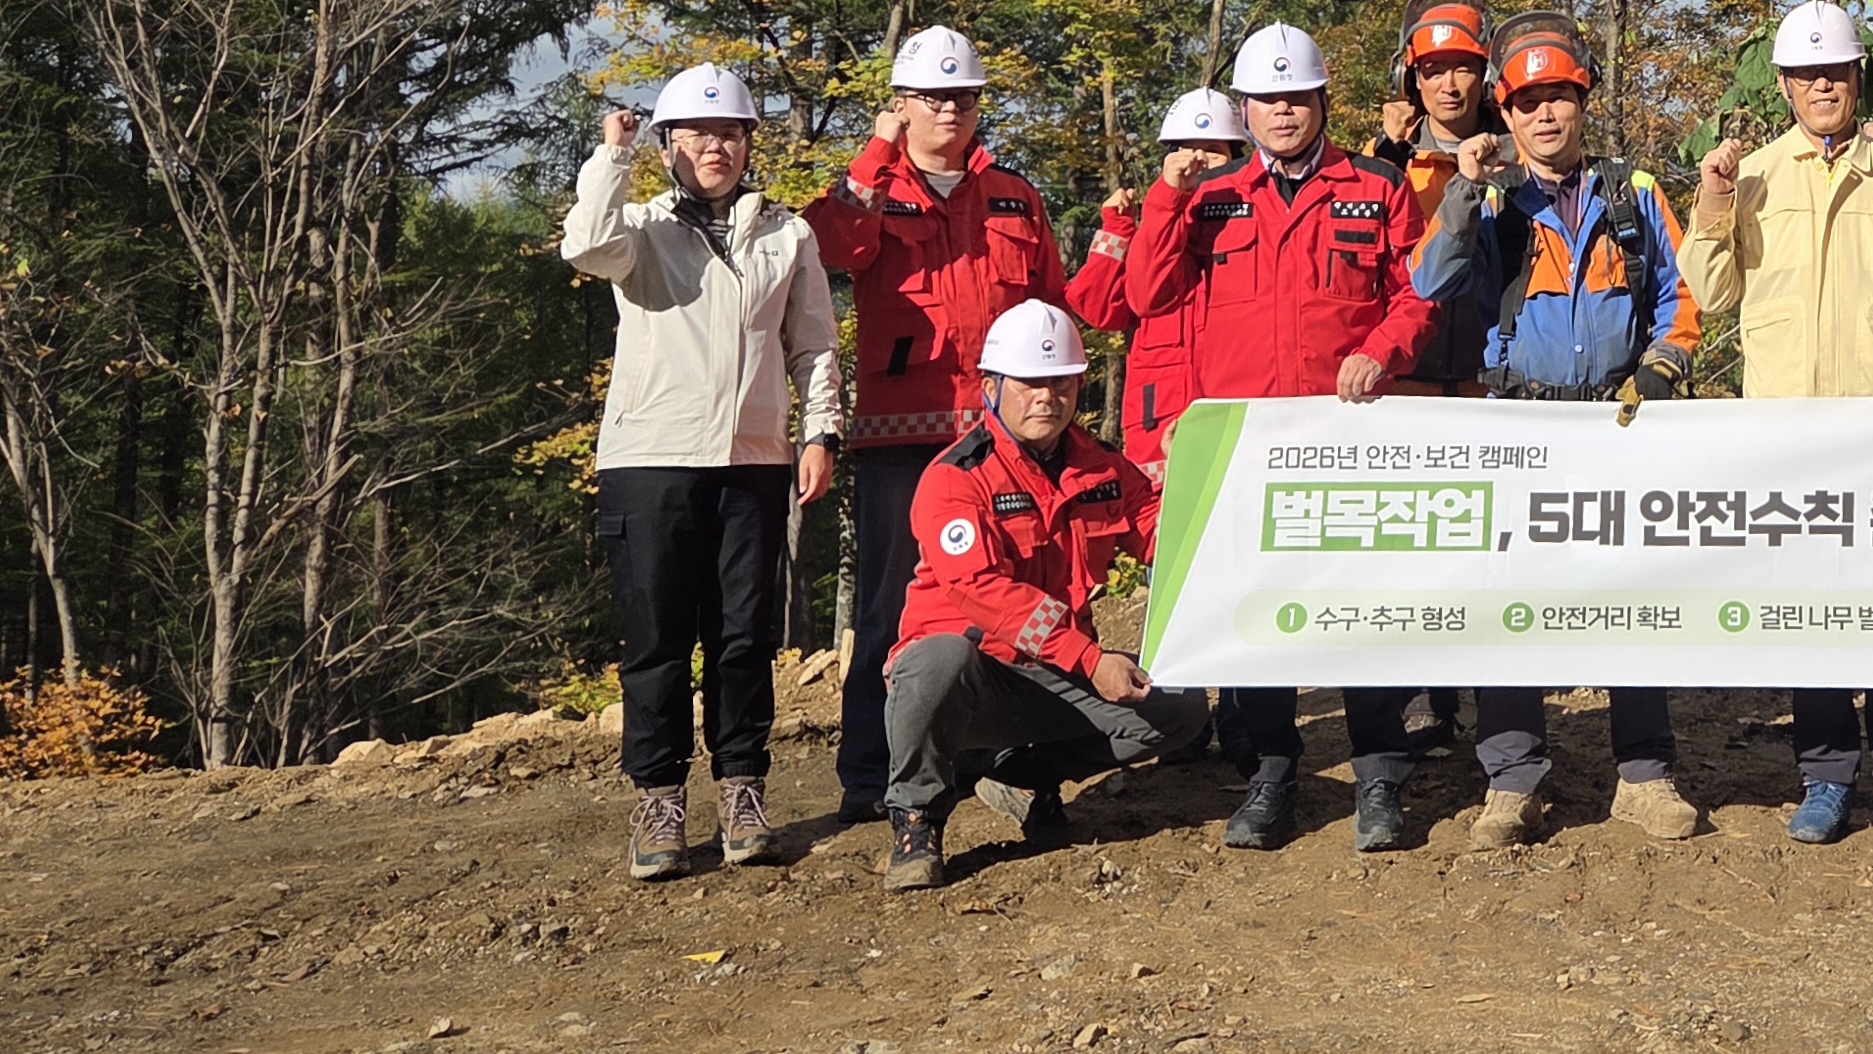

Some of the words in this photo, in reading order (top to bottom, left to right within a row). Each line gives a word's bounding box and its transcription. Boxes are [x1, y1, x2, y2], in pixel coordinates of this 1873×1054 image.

[1268, 445, 1358, 470] 2026년
[1366, 445, 1470, 470] 안전·보건
[1478, 445, 1548, 469] 캠페인
[1528, 490, 1626, 546] 5대
[1639, 490, 1855, 547] 안전수칙
[1287, 608, 1297, 628] 1
[1315, 605, 1416, 632] 수구·추구
[1421, 606, 1466, 631] 형성
[1510, 608, 1526, 627] 2
[1542, 606, 1632, 631] 안전거리
[1636, 605, 1682, 631] 확보
[1727, 606, 1742, 626] 3
[1759, 605, 1803, 630] 걸린
[1808, 605, 1854, 631] 나무
